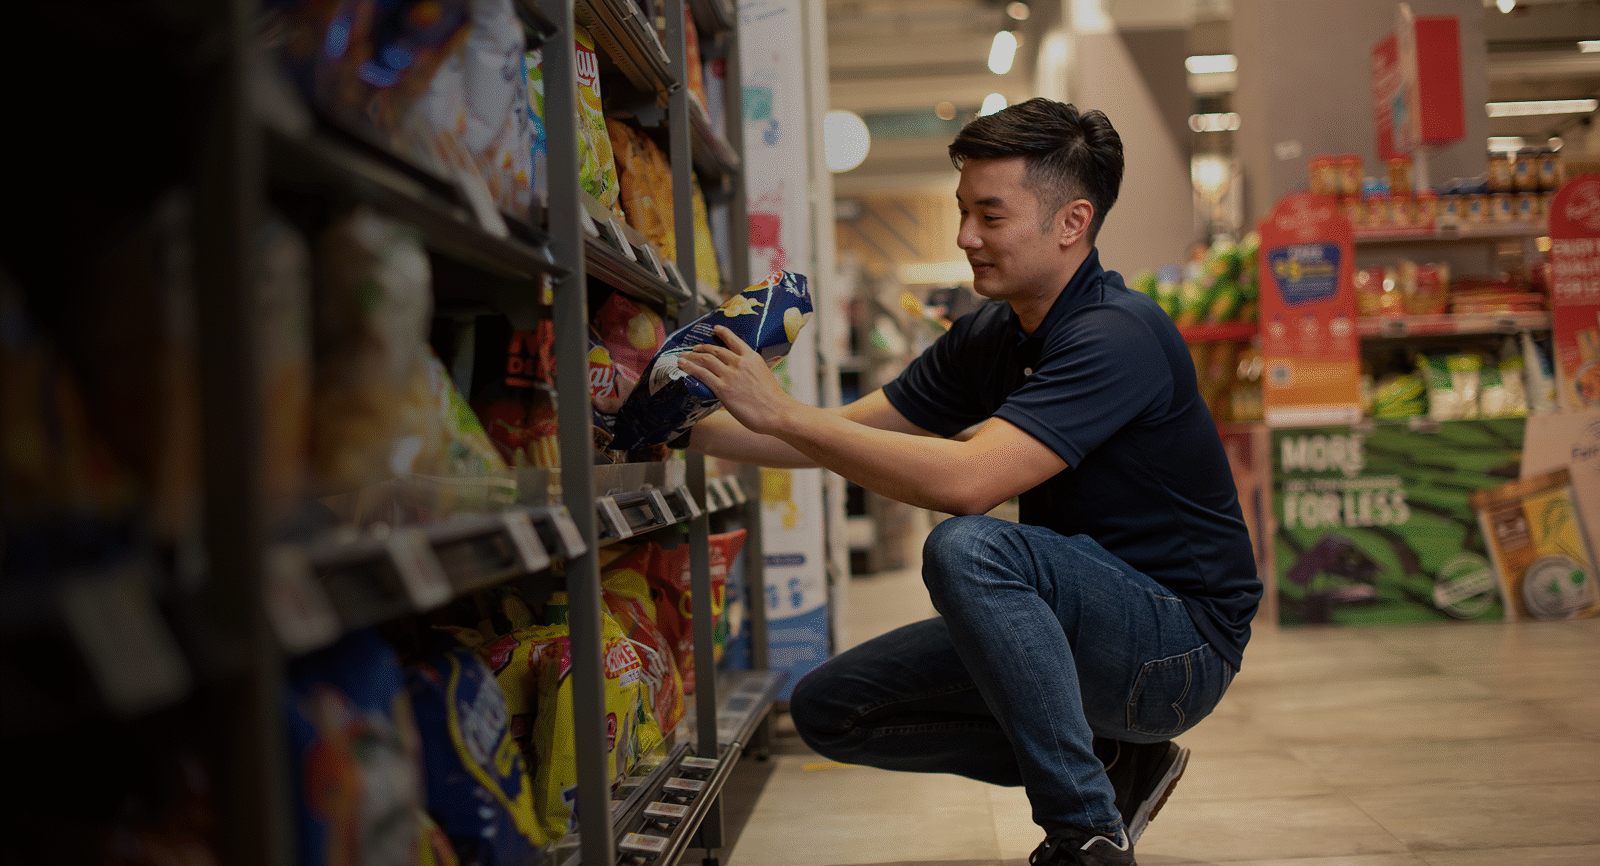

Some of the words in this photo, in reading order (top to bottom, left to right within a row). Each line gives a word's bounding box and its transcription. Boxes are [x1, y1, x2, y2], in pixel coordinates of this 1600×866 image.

[1280, 434, 1366, 474] MORE
[1284, 492, 1341, 529] FOR
[1344, 489, 1410, 527] LESS
